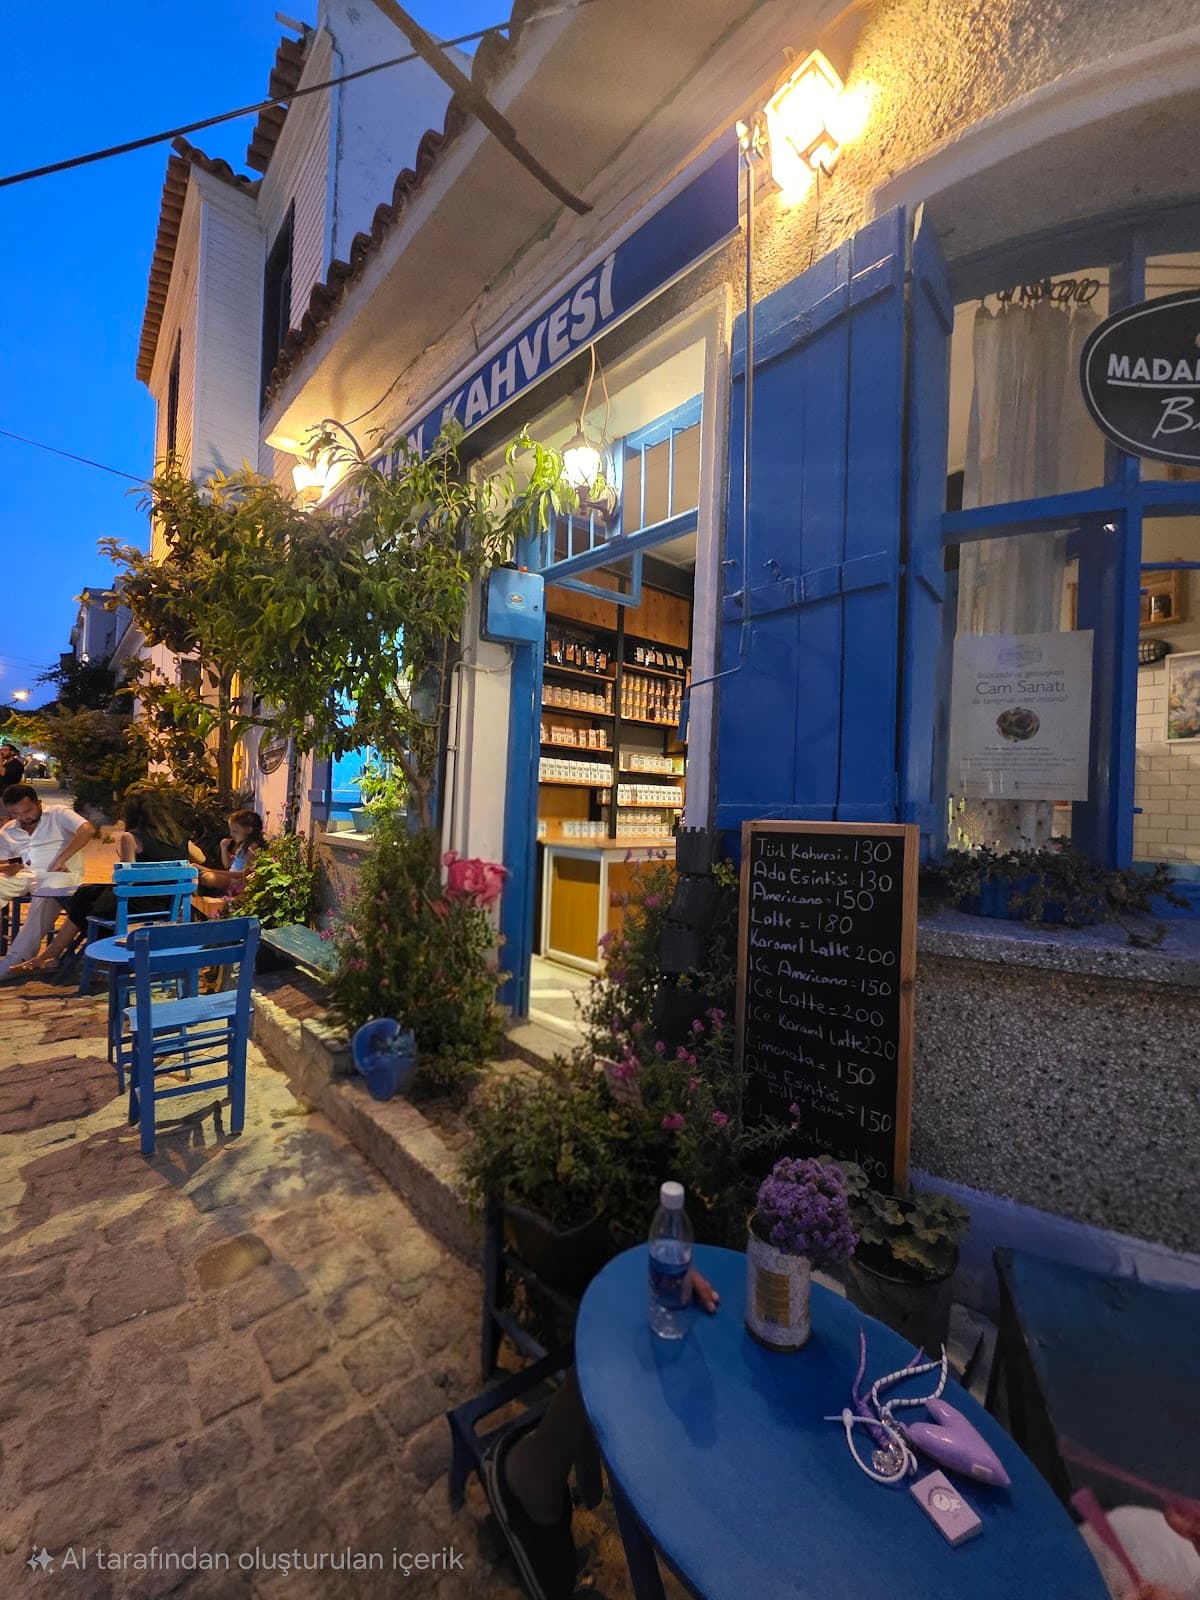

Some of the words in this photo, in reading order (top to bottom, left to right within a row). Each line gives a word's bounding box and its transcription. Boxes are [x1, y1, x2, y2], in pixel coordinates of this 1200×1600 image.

[440, 252, 616, 432] KAHVESİ
[1107, 353, 1200, 382] MADA
[976, 681, 1012, 695] Cam
[1017, 679, 1065, 694] Sanatı
[791, 842, 841, 861] Kahvesi
[854, 840, 892, 864] 130
[753, 860, 786, 881] Ada
[790, 868, 848, 886] Esintisi
[860, 870, 893, 893] 130
[752, 881, 823, 905] Americano
[836, 890, 874, 911] 150
[751, 907, 792, 928] Latte
[817, 913, 853, 934] 180
[750, 928, 804, 954] Karamel
[811, 939, 850, 958] Latte
[856, 946, 896, 967] 200
[777, 959, 848, 986] Americano
[861, 979, 892, 997] 150
[779, 985, 826, 1014] Latte
[842, 1003, 884, 1027] 200
[859, 1035, 896, 1061] 220
[836, 1060, 876, 1086] 150
[860, 1104, 892, 1133] 150
